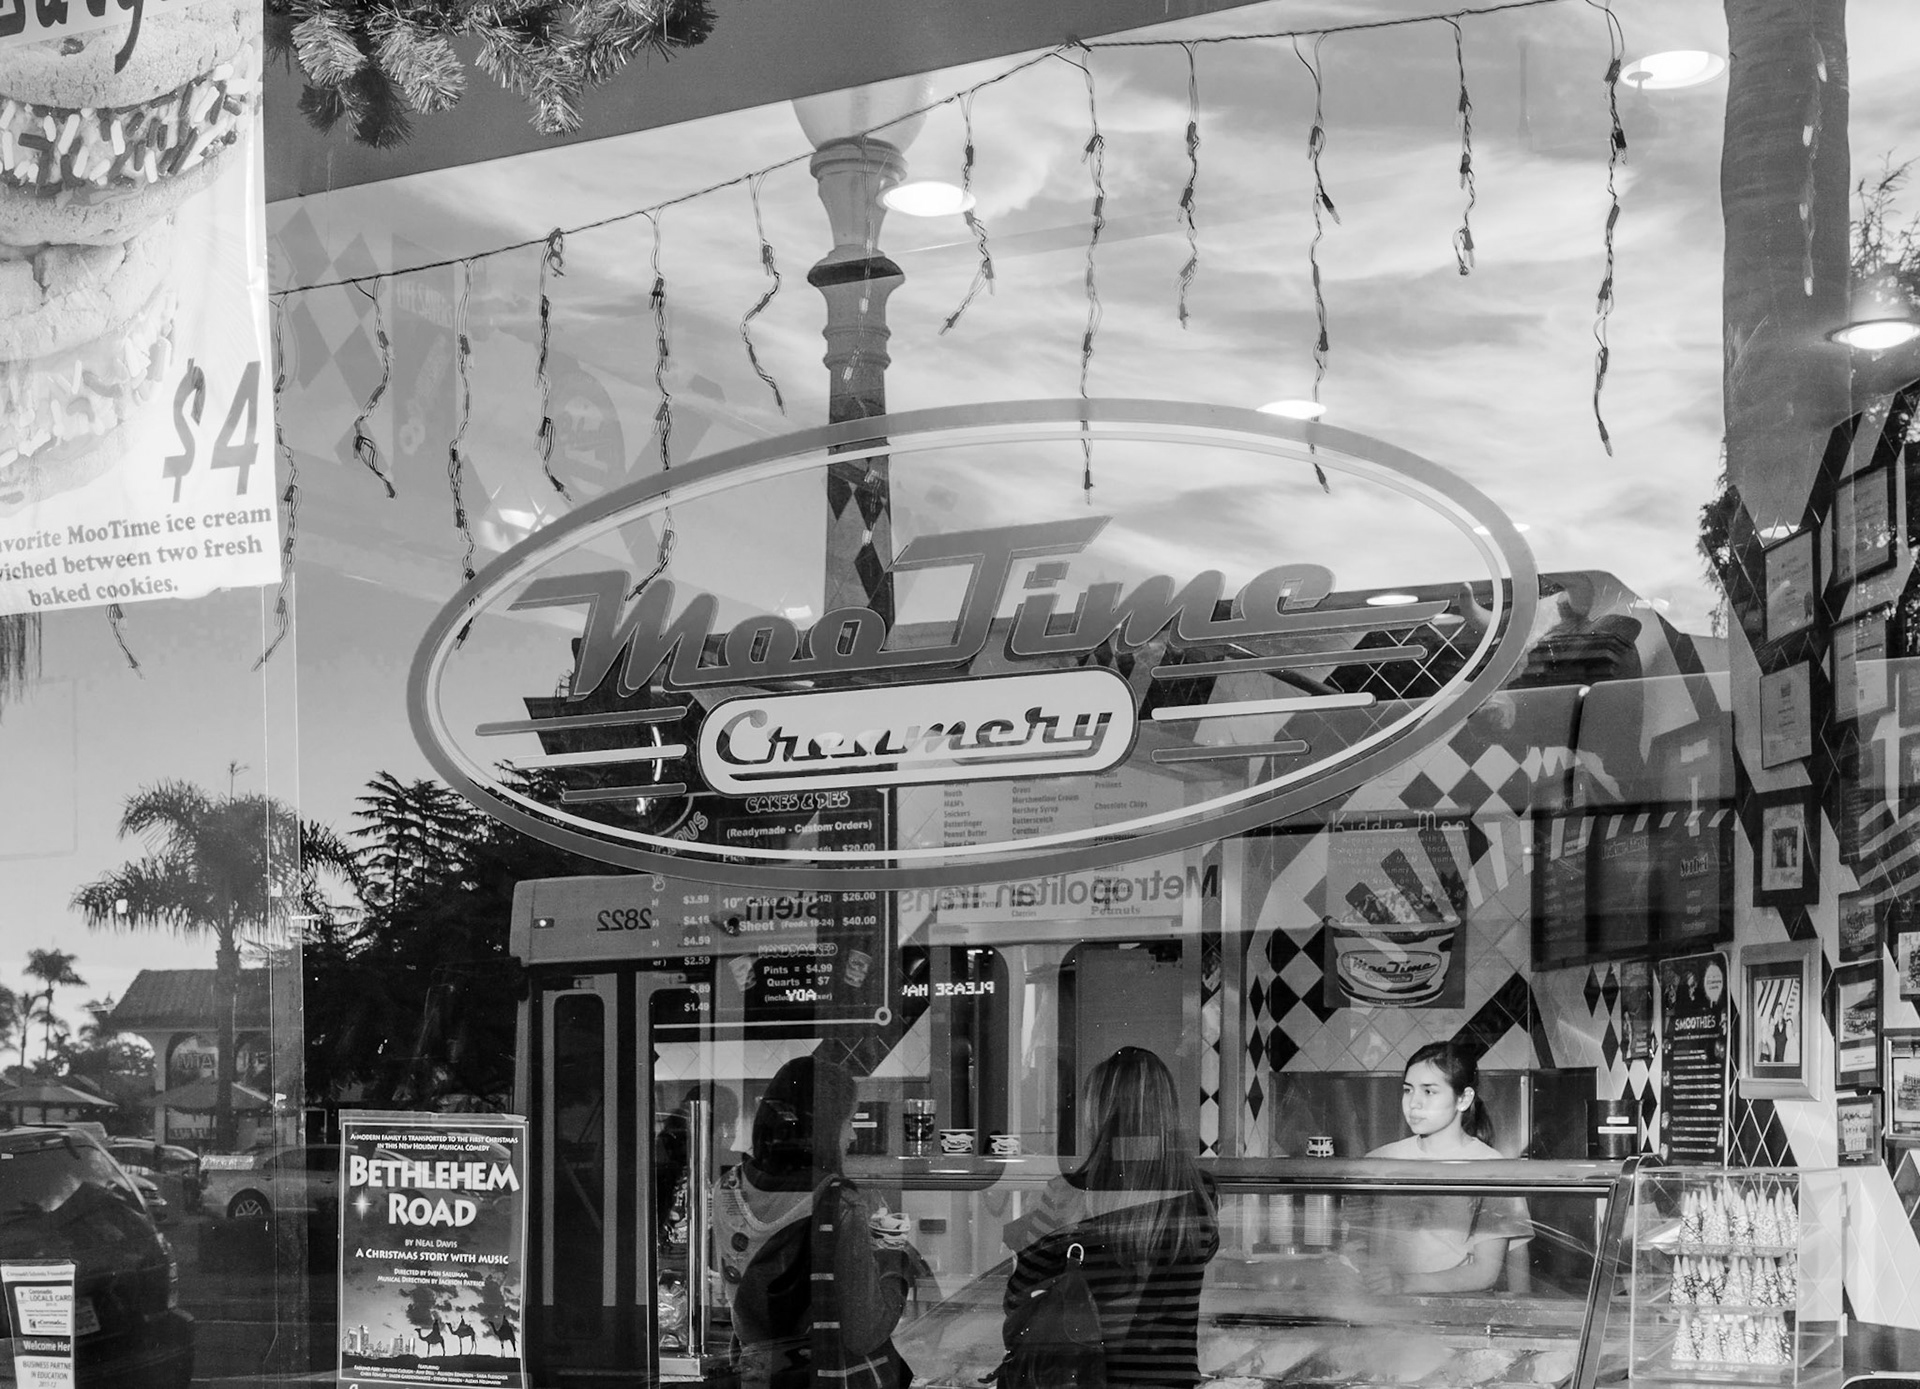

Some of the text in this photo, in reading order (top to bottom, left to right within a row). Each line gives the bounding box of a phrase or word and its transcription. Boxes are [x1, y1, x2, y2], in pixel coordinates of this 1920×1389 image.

[162, 357, 262, 503] $4
[0, 507, 272, 553] vorite MooTime ice cream
[63, 550, 152, 574] between
[157, 545, 198, 564] two
[203, 534, 263, 559] fresh
[28, 575, 179, 608] baked cookies.
[715, 706, 1113, 776] Creamery
[745, 794, 800, 814] CAKES
[815, 790, 851, 809] PIES
[726, 819, 873, 839] (Readymade Custom Orders)
[1332, 812, 1404, 834] Kiddie
[842, 892, 876, 902] $26.00
[739, 921, 775, 932] Sheet
[842, 916, 877, 926] $40.00
[684, 936, 710, 946] $4.59
[684, 956, 710, 966] $2.59
[763, 963, 833, 975] Pints $4.99
[767, 976, 830, 987] Quarts $7
[684, 1002, 710, 1012] $1.49
[1675, 1014, 1716, 1031] SMOOTHIES
[350, 1155, 520, 1192] BETHLEHEM
[388, 1193, 476, 1228] ROAD
[355, 1248, 509, 1265] A CHRISTMAS STORY WITH MUSIC
[23, 1340, 56, 1351] Welcome
[23, 1361, 49, 1369] BUSINESS
[37, 1371, 68, 1380] EDUCATION
